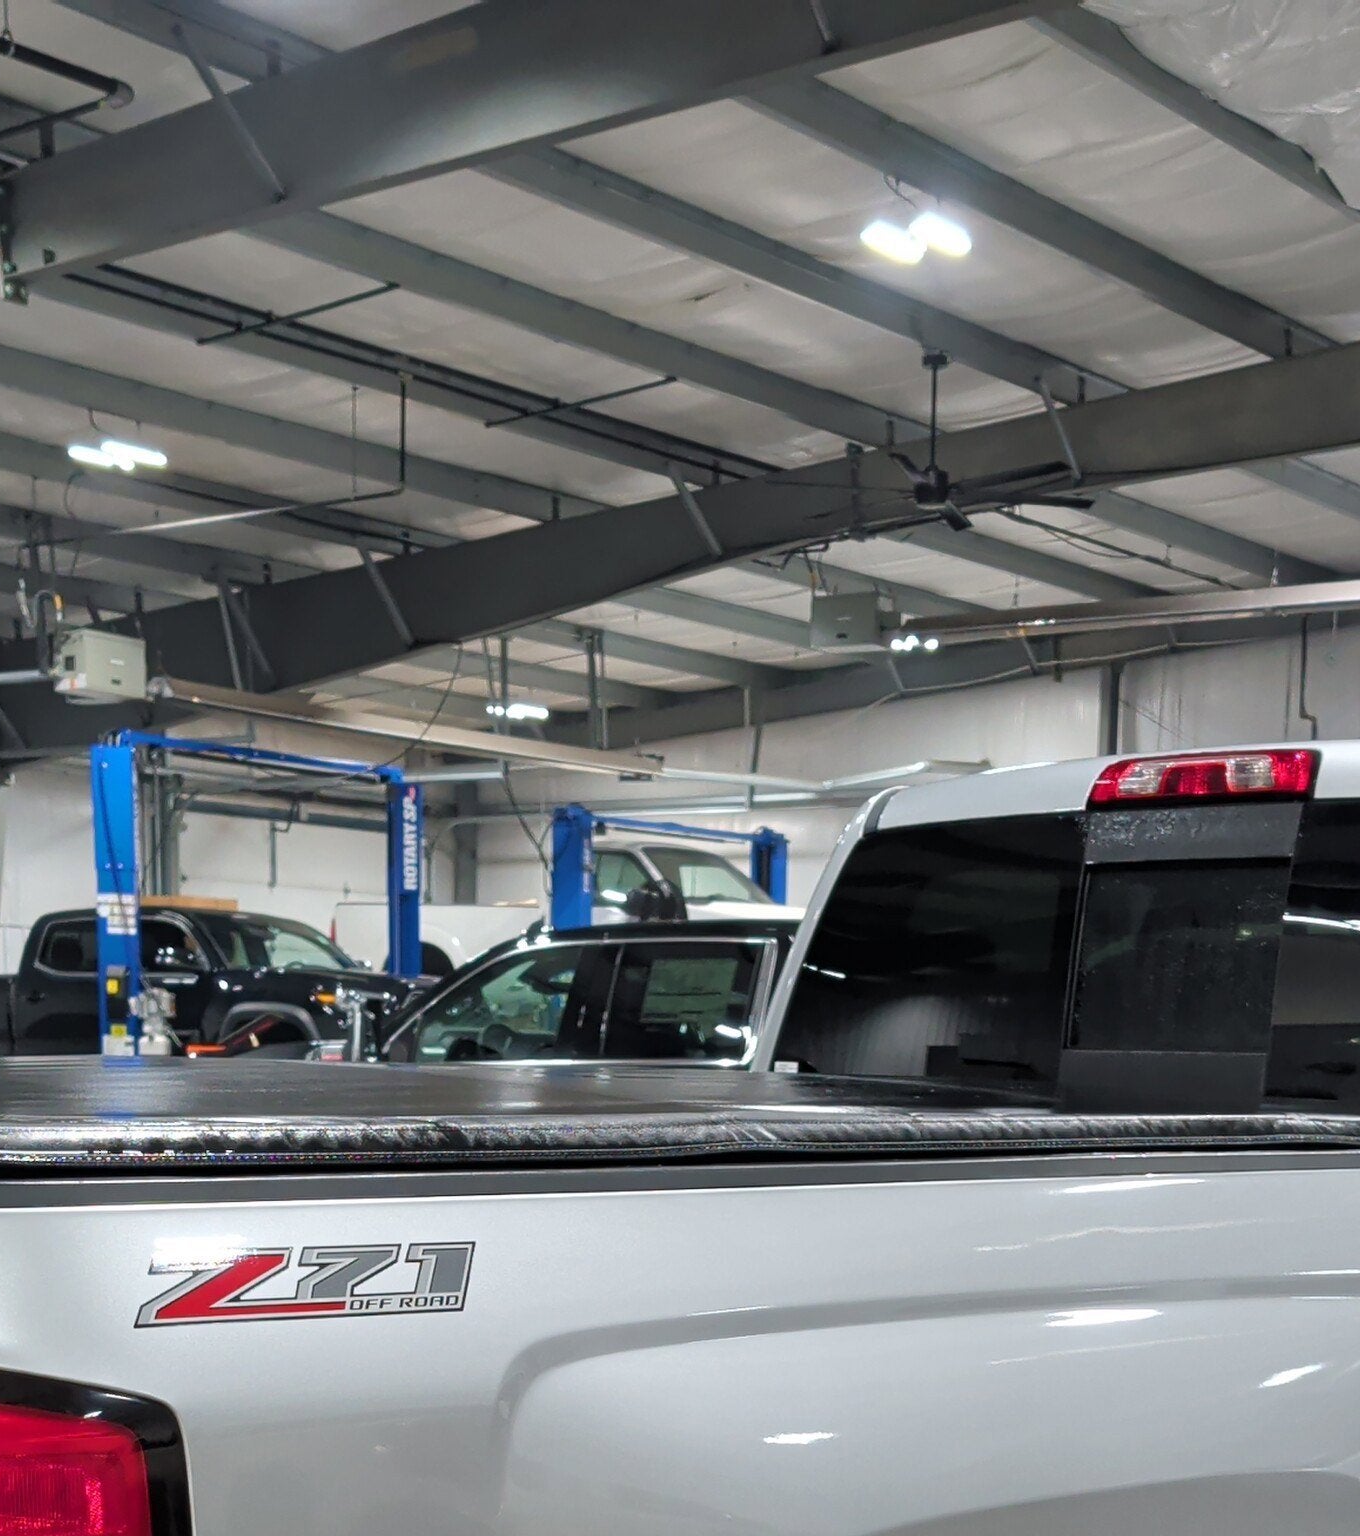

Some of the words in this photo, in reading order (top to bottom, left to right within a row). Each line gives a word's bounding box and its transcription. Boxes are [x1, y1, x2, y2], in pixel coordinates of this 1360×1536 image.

[402, 823, 418, 890] ROTARY
[133, 1240, 476, 1329] Z71
[349, 1298, 392, 1312] OFF
[398, 1294, 459, 1309] ROAD
